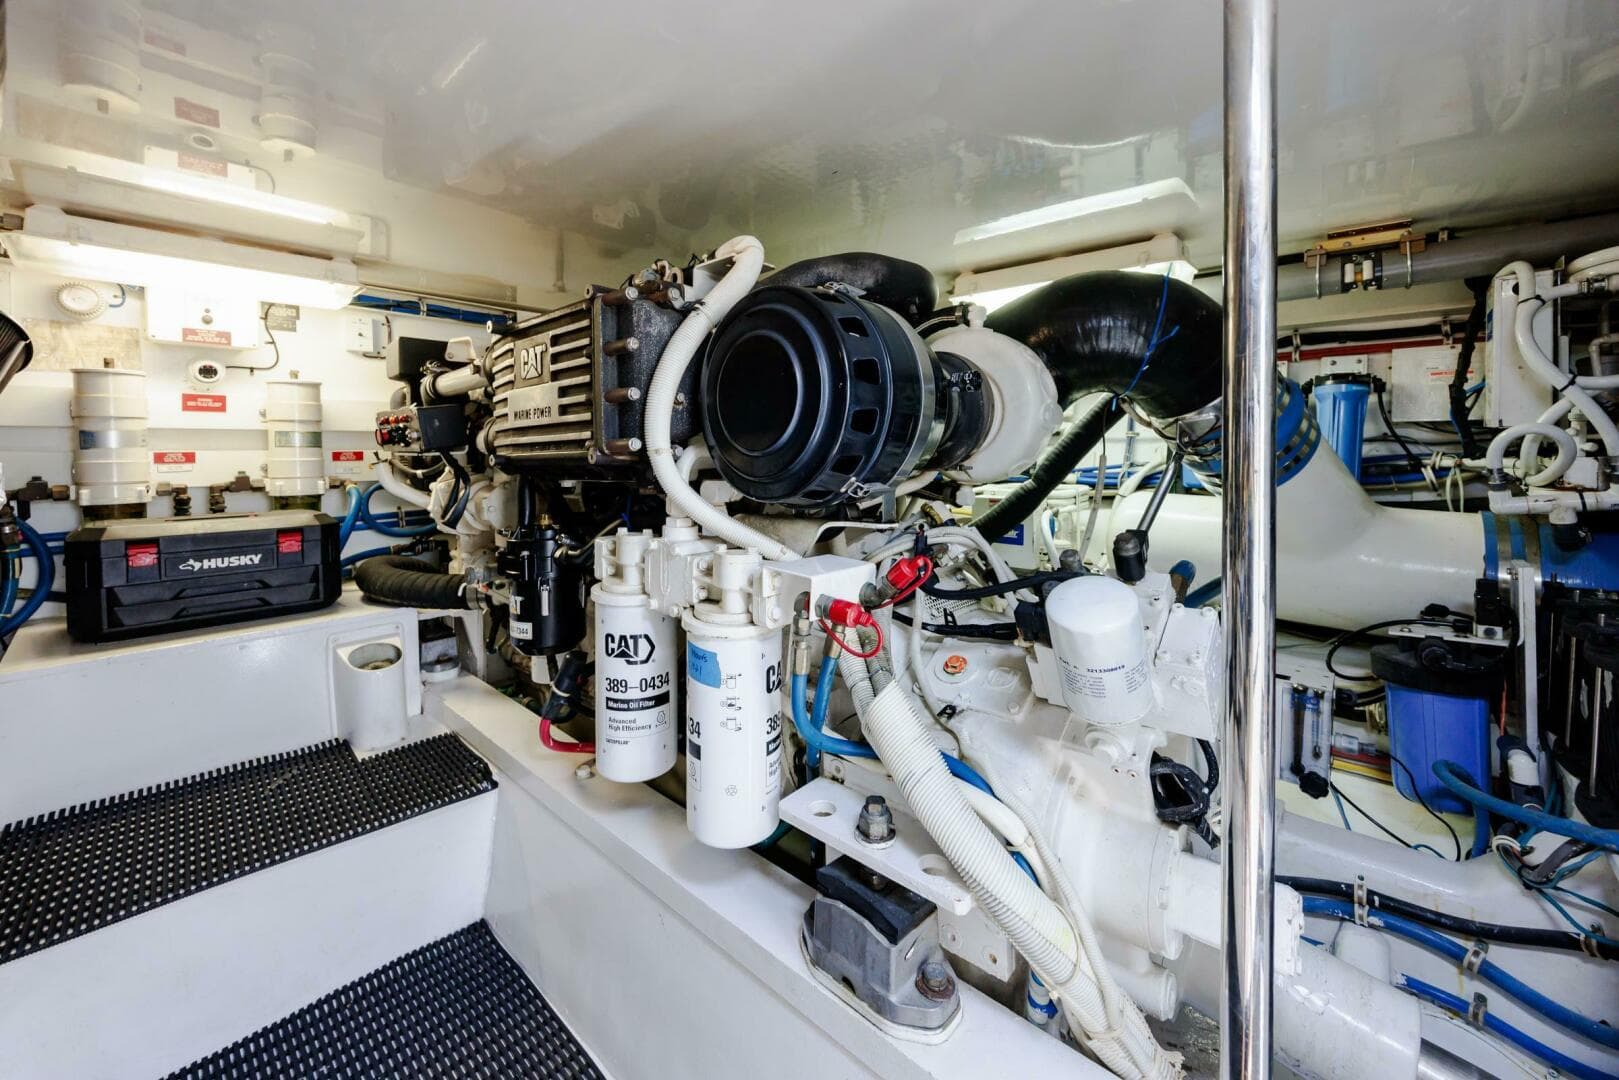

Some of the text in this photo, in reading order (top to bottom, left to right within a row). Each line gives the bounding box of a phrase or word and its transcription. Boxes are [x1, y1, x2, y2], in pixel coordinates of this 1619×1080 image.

[520, 343, 548, 380] CAT
[513, 405, 552, 421] MARINE POWER
[202, 553, 263, 569] HUSKY
[605, 633, 642, 658] CAT
[605, 671, 670, 694] 389-0434
[607, 700, 628, 709] Marine
[640, 700, 656, 708] Filter
[608, 716, 637, 725] Advanced
[608, 724, 652, 732] High Efficiency
